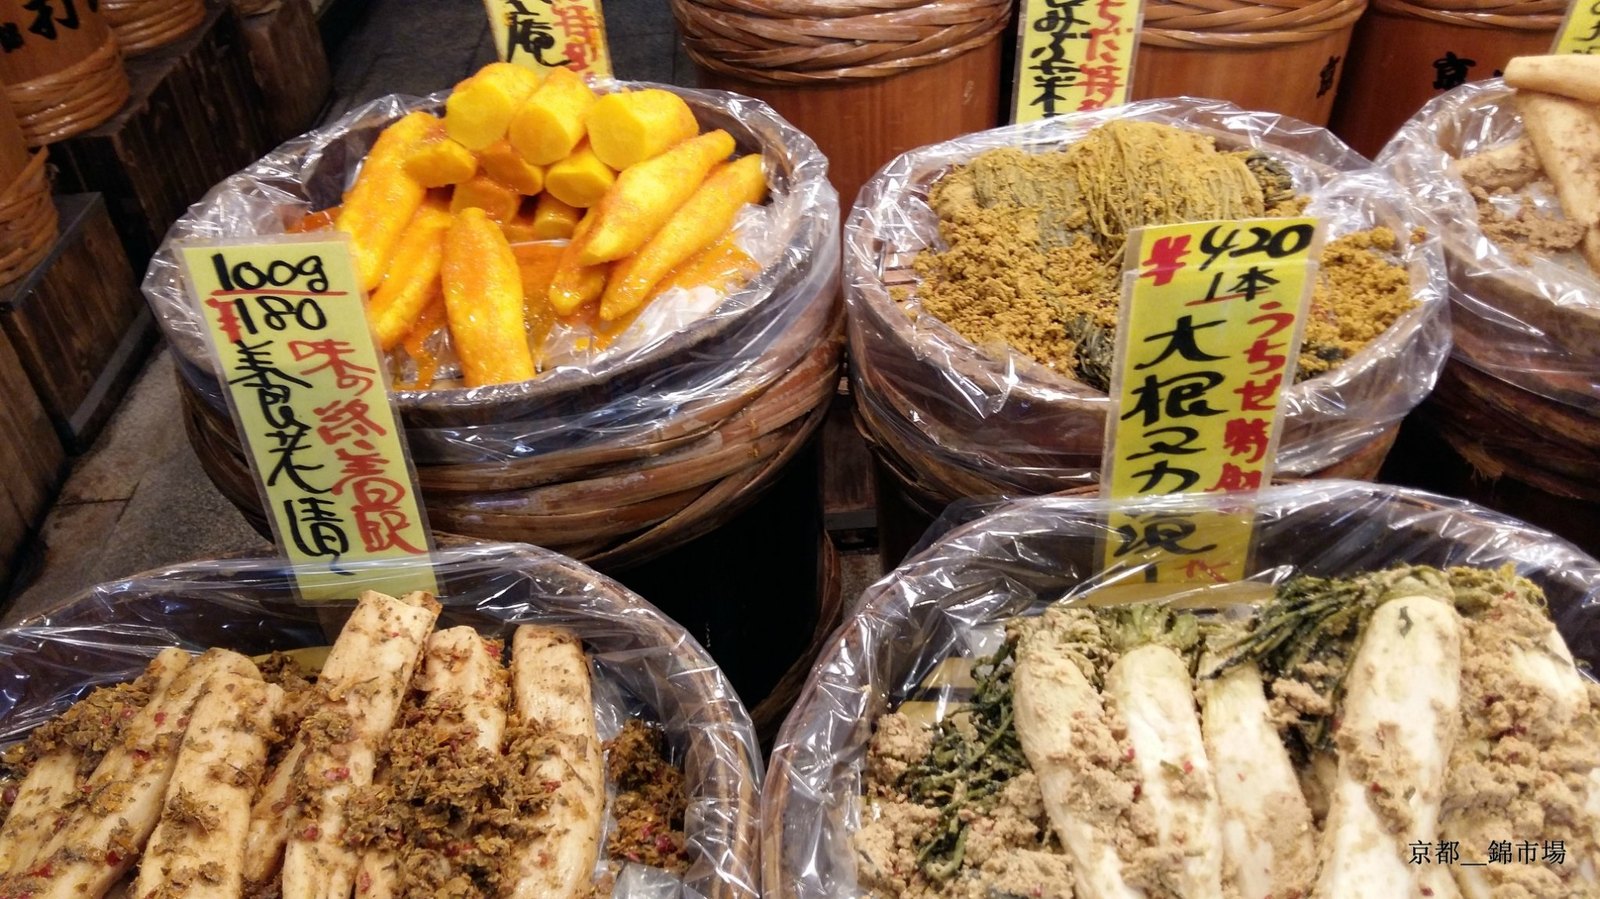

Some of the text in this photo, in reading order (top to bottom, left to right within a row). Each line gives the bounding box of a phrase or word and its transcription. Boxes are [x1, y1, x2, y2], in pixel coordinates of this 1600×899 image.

[504, 0, 573, 67] 庵
[211, 253, 329, 293] 100g
[1204, 266, 1280, 301] 1本
